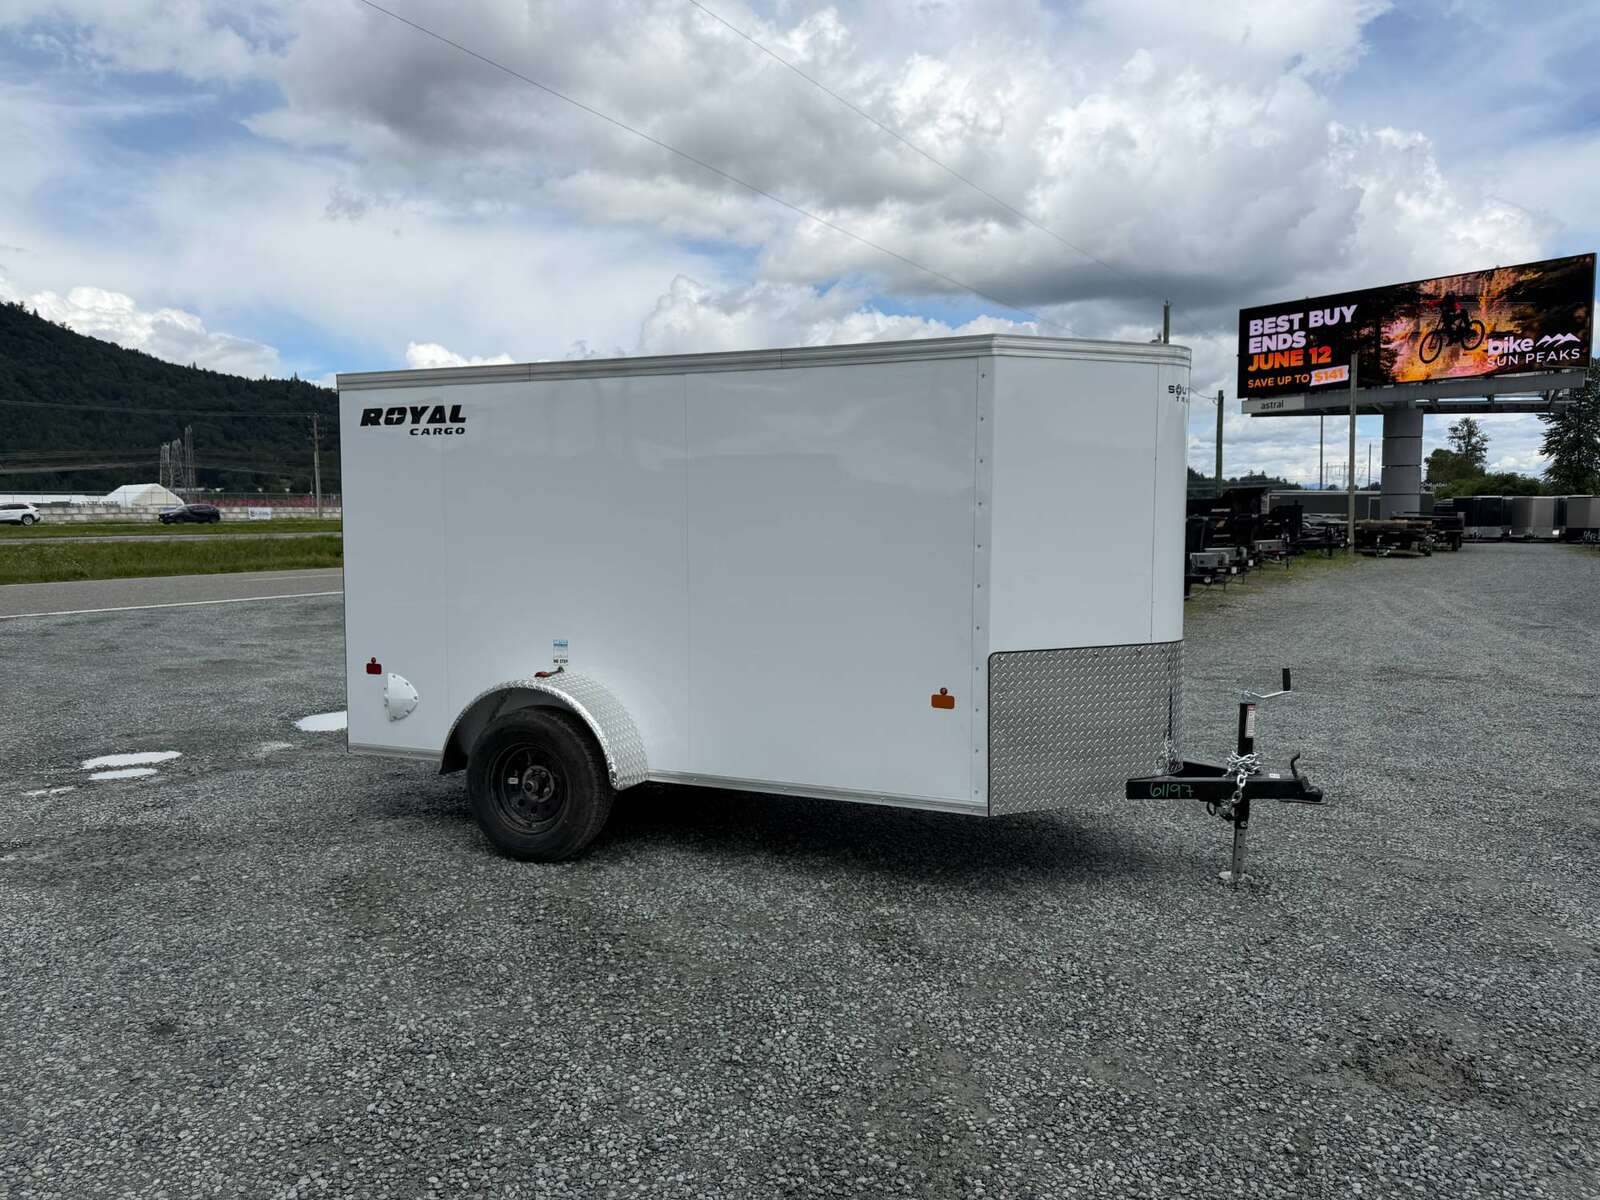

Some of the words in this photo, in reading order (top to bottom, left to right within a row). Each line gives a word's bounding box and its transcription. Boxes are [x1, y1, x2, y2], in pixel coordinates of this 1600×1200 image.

[1249, 312, 1304, 336] BEST
[1308, 304, 1358, 328] BUY
[1248, 331, 1306, 354] ENDS
[1487, 336, 1534, 356] bike
[1247, 349, 1304, 371] JUNE
[1308, 345, 1332, 364] 12
[1487, 354, 1519, 367] SUN
[1525, 348, 1580, 364] PEAKS
[1247, 376, 1275, 389] SAVE
[1277, 375, 1292, 385] UP
[1294, 373, 1310, 383] TO
[1260, 399, 1284, 410] astral
[360, 405, 467, 427] ROYAL
[409, 427, 466, 436] CARGO
[1150, 782, 1194, 798] 61197
